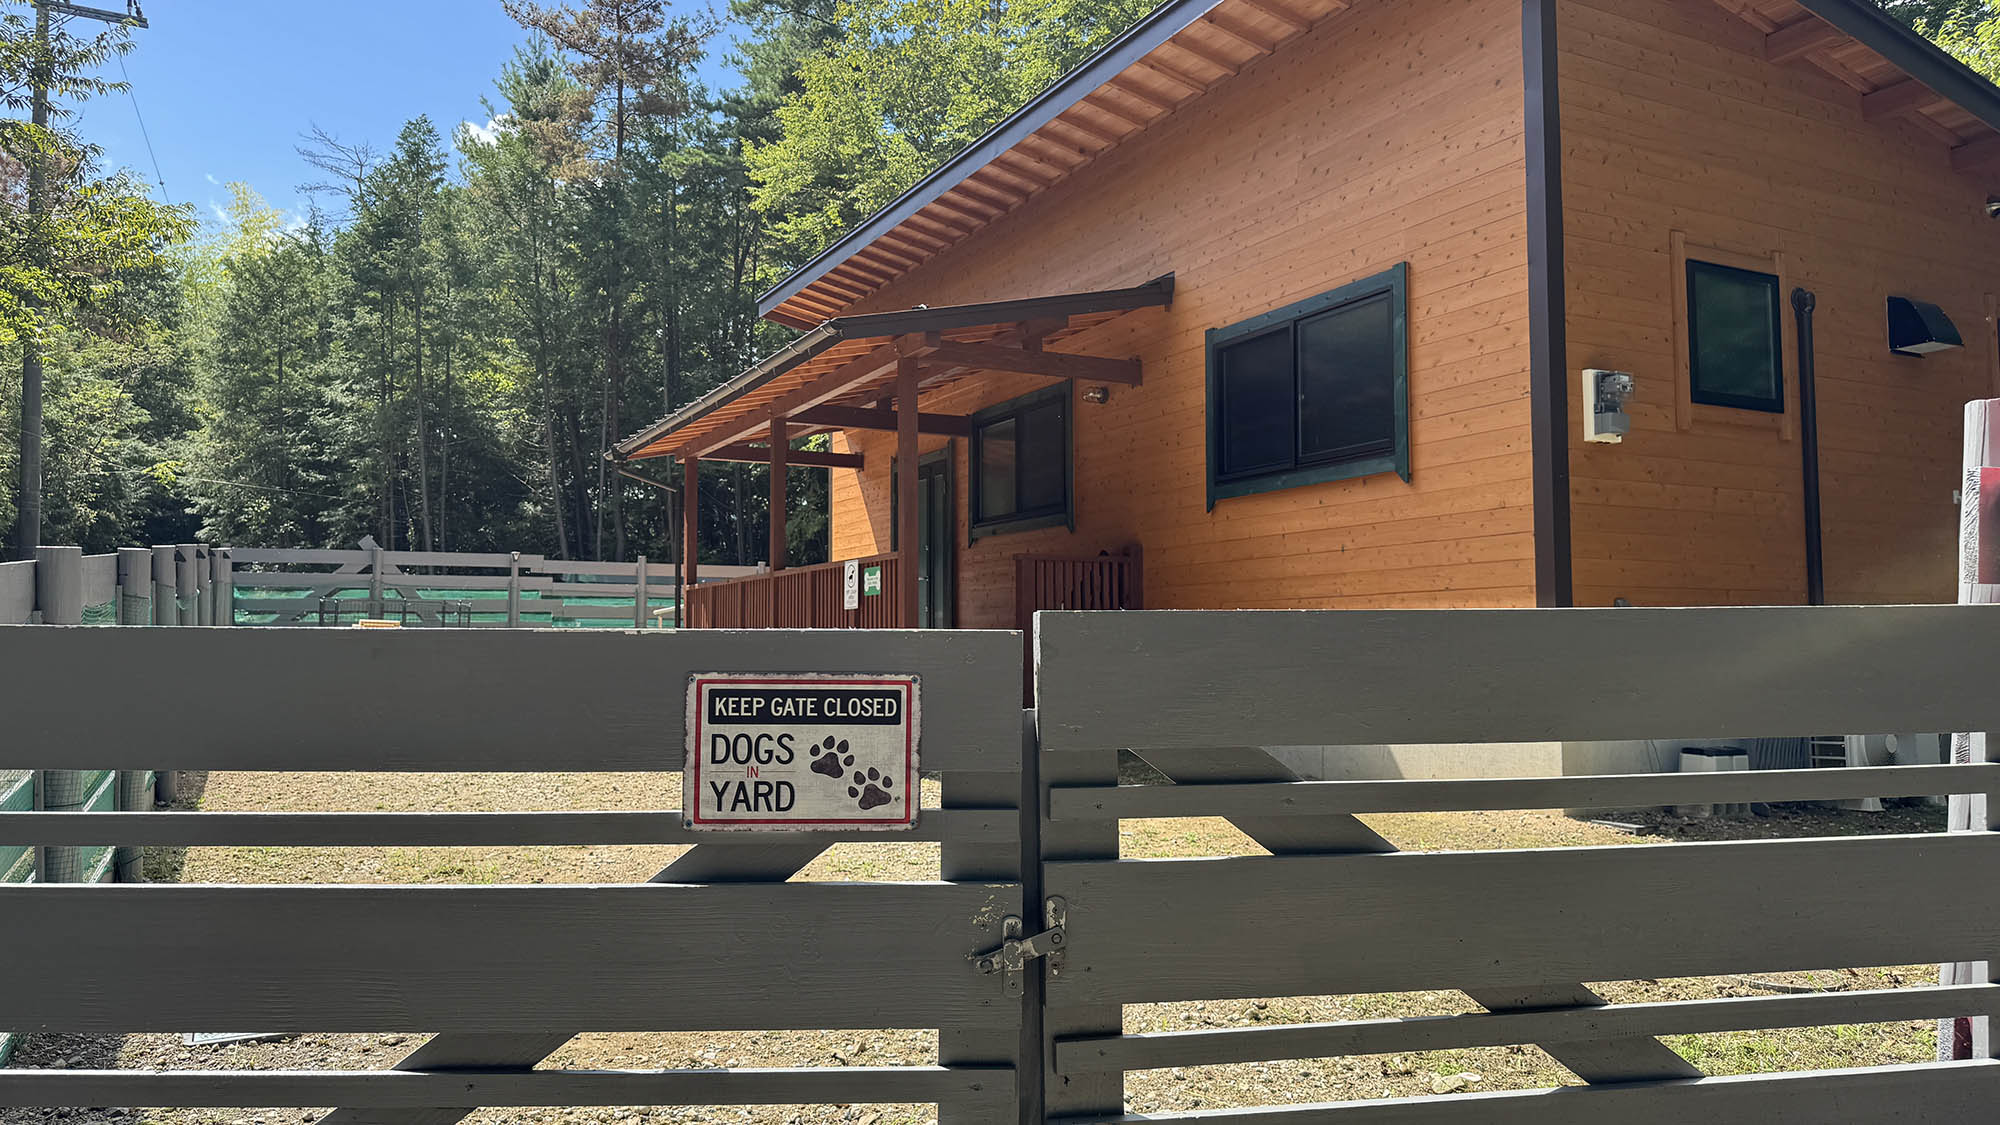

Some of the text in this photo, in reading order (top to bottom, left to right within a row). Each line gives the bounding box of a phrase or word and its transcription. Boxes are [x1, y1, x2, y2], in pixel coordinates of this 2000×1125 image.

[715, 697, 897, 717] KEEP GATE CLOSED
[710, 733, 795, 765] DOGS
[746, 765, 759, 778] IN
[709, 780, 796, 813] YARD
